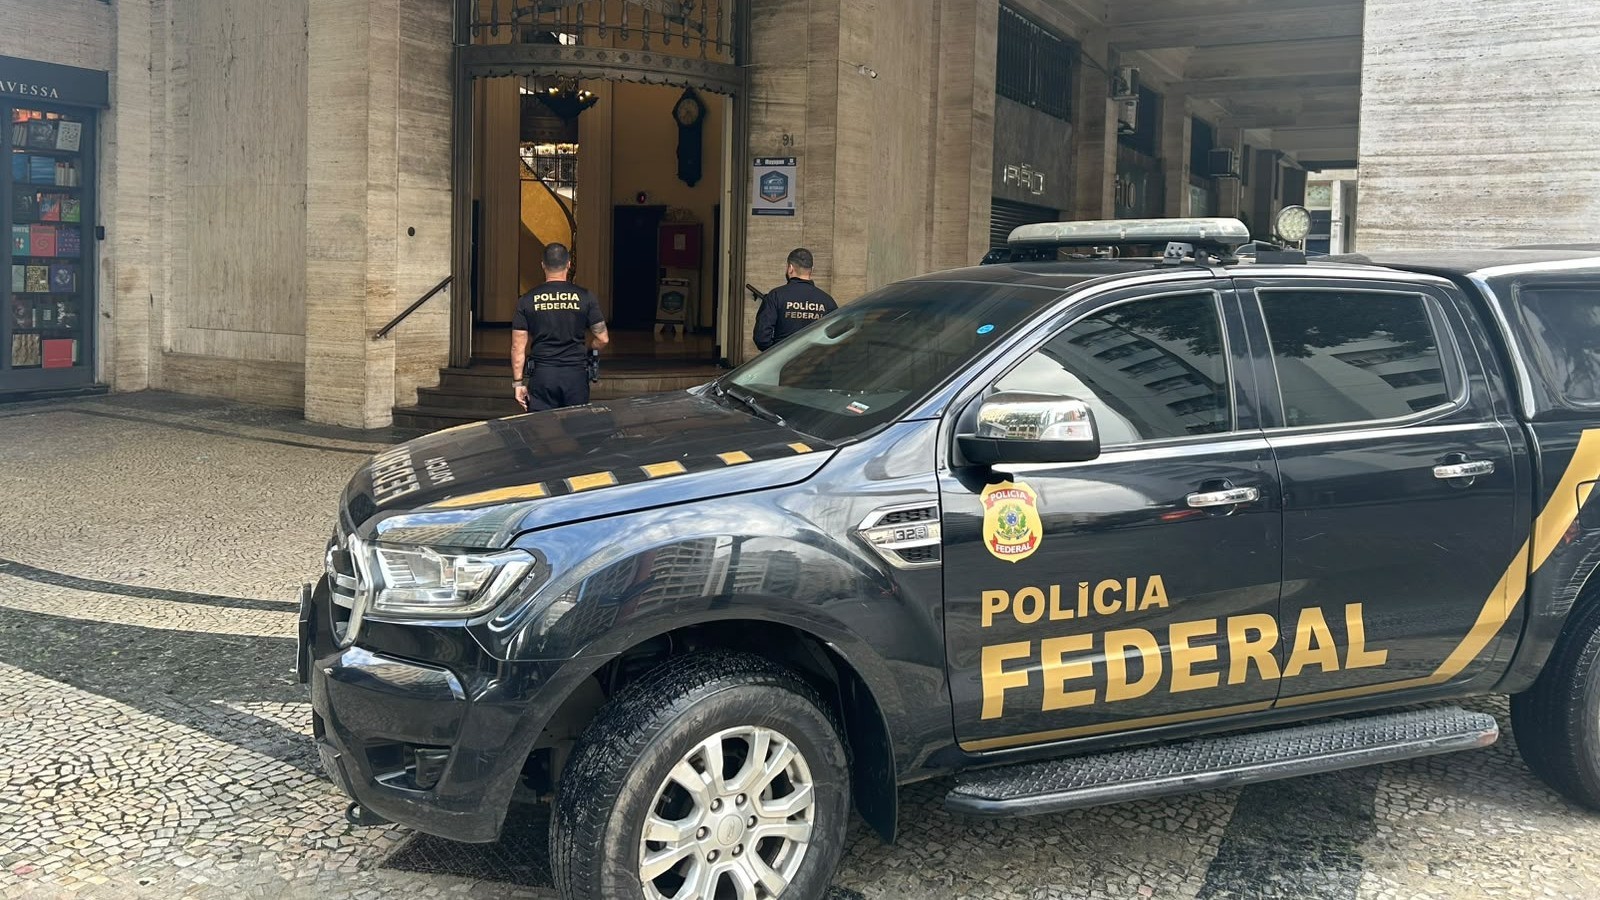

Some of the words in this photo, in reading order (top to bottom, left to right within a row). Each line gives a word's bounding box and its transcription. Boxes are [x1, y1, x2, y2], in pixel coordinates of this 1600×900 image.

[533, 291, 580, 303] POLÍCIA
[534, 302, 580, 311] FEDERAL
[786, 300, 826, 312] POLÍCIA
[995, 542, 1032, 554] FEDERAL
[981, 602, 1388, 721] FEDERAL
